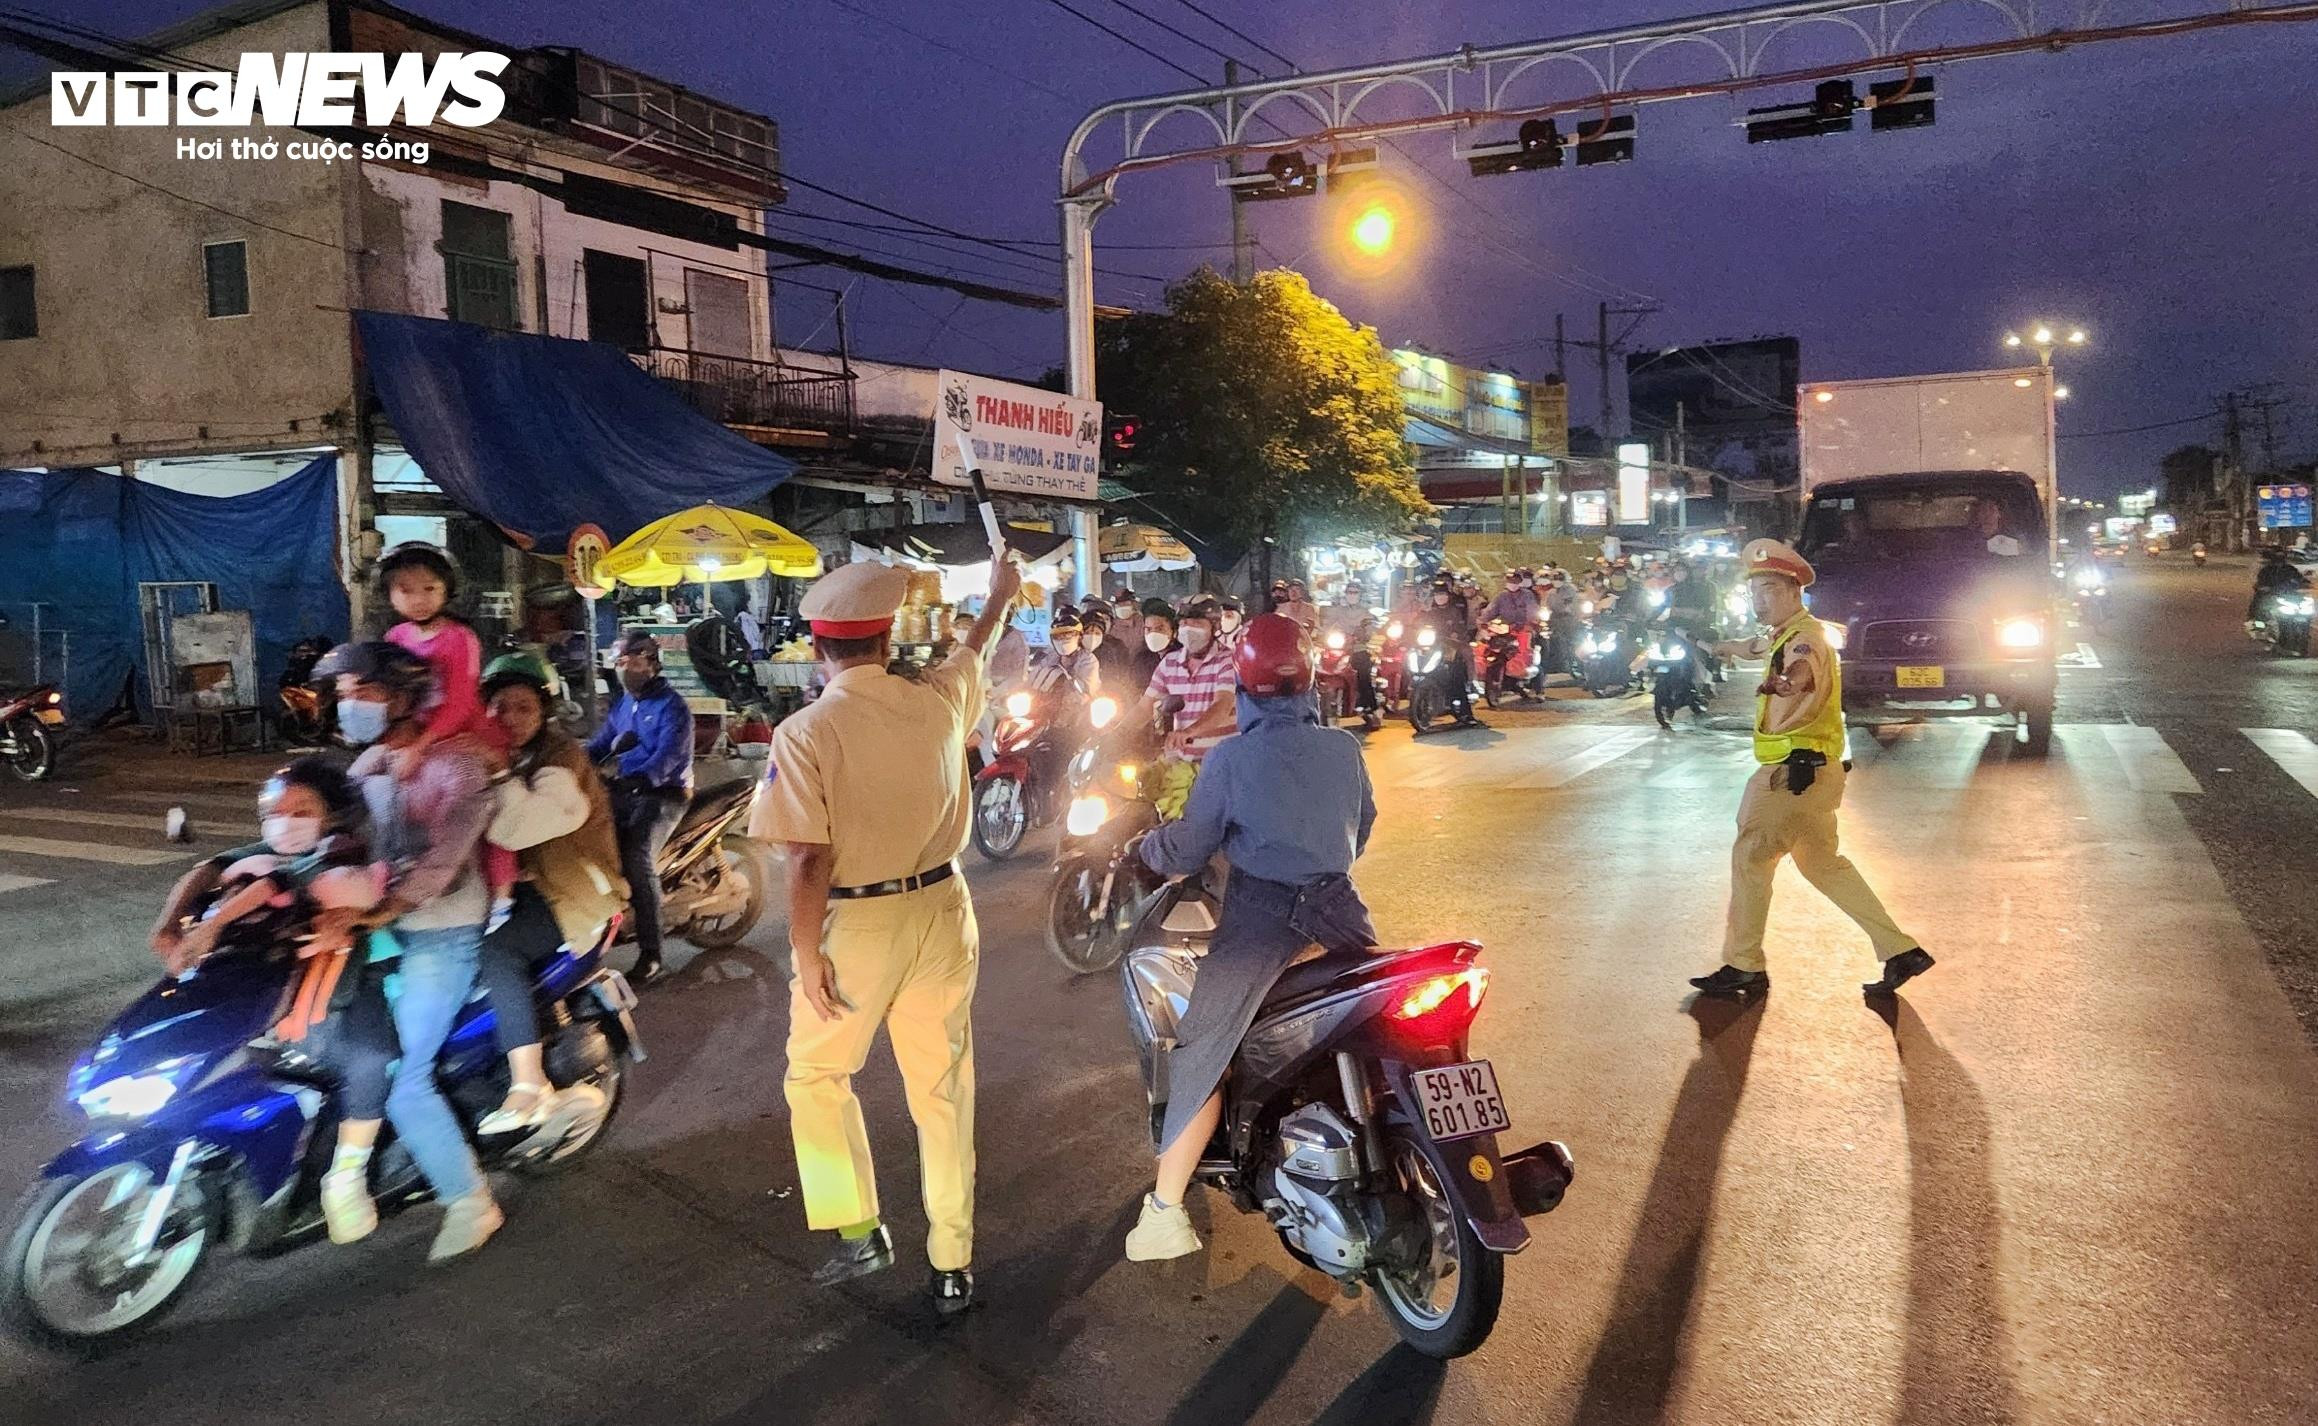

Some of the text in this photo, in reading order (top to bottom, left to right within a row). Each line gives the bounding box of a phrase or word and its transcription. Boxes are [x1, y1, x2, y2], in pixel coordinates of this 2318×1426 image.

[976, 395, 1074, 438] THANH HIẾU
[1008, 443, 1043, 469] HONDA
[1052, 450, 1065, 471] XE
[1067, 453, 1082, 473] TAY
[1084, 455, 1096, 475] GA
[1036, 475, 1065, 490] THAY
[1425, 1067, 1488, 1103] 59-N2
[1428, 1096, 1503, 1136] 601.85
